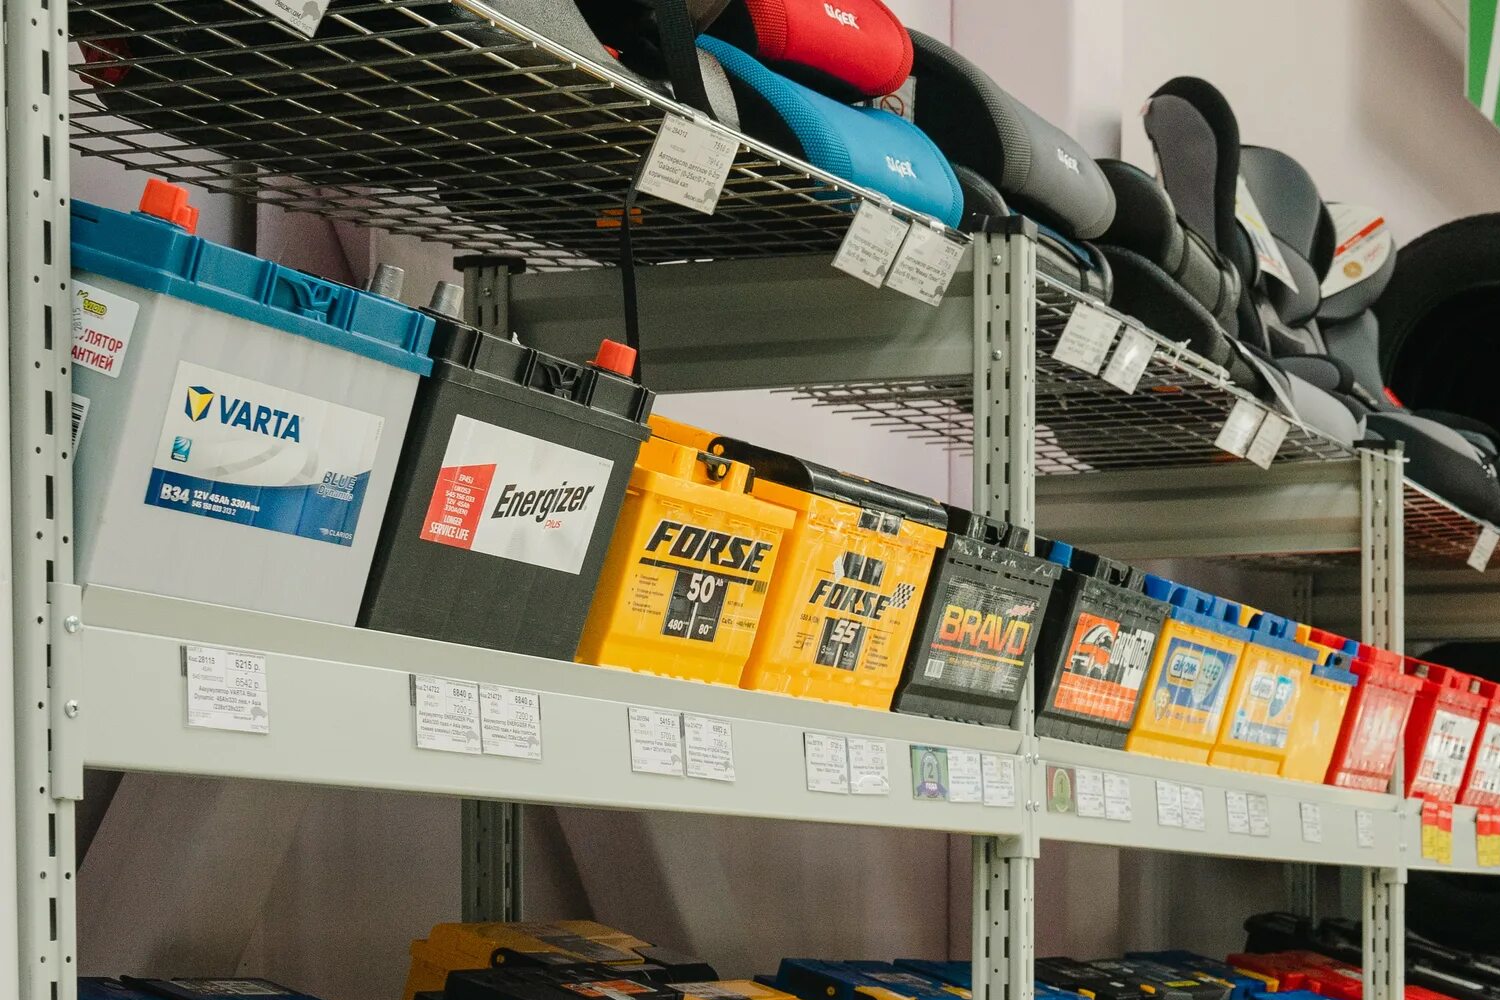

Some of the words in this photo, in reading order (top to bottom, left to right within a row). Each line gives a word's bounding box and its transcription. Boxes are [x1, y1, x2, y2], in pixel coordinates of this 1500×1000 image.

[220, 394, 301, 444] VARTA
[322, 471, 356, 490] BLUE
[160, 483, 190, 504] B34
[193, 489, 209, 502] 12V
[209, 491, 230, 506] 45Ah
[316, 484, 354, 501] Dynamic
[491, 481, 596, 523] Energizer
[443, 514, 463, 527] LONGER
[544, 519, 562, 530] plus
[329, 527, 353, 540] CLARIOS
[429, 522, 455, 539] SERVICE
[455, 528, 470, 541] LIFE
[645, 519, 773, 574] FORSE
[686, 573, 715, 604] 50
[808, 578, 892, 621] FORSE
[667, 618, 683, 633] 480
[830, 618, 860, 644] 55
[938, 603, 1032, 656] BRAVO
[452, 687, 467, 699] 6840
